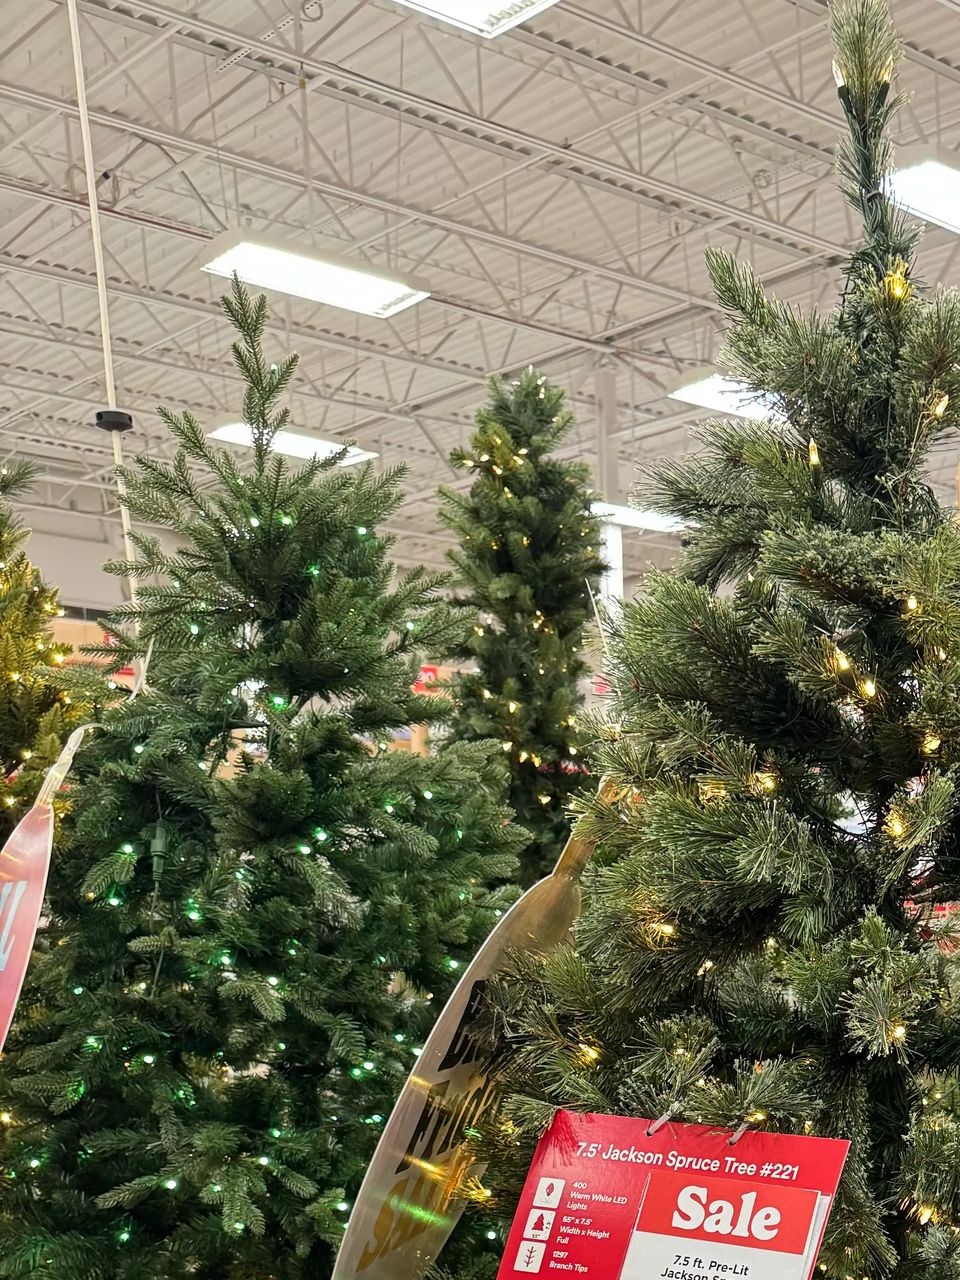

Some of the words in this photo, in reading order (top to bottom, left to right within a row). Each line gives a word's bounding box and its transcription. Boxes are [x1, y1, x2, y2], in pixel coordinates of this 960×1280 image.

[576, 1142, 602, 1158] 7.5'
[602, 1146, 663, 1168] Jackson
[665, 1150, 720, 1171] Spruce
[724, 1156, 758, 1176] Tree
[759, 1162, 800, 1180] #221
[573, 1181, 587, 1189] 400
[570, 1191, 590, 1201] Warm
[591, 1193, 612, 1203] White
[613, 1196, 627, 1204] LED
[567, 1201, 587, 1211] Lights
[672, 1185, 782, 1241] Sale
[560, 1226, 580, 1236] Width
[586, 1231, 610, 1240] Height
[556, 1236, 569, 1244] Full
[549, 1261, 573, 1270] Branch
[574, 1263, 588, 1273] Tips
[673, 1254, 691, 1267] 7.5
[693, 1257, 705, 1269] ft.
[708, 1260, 749, 1276] Pre-Lit
